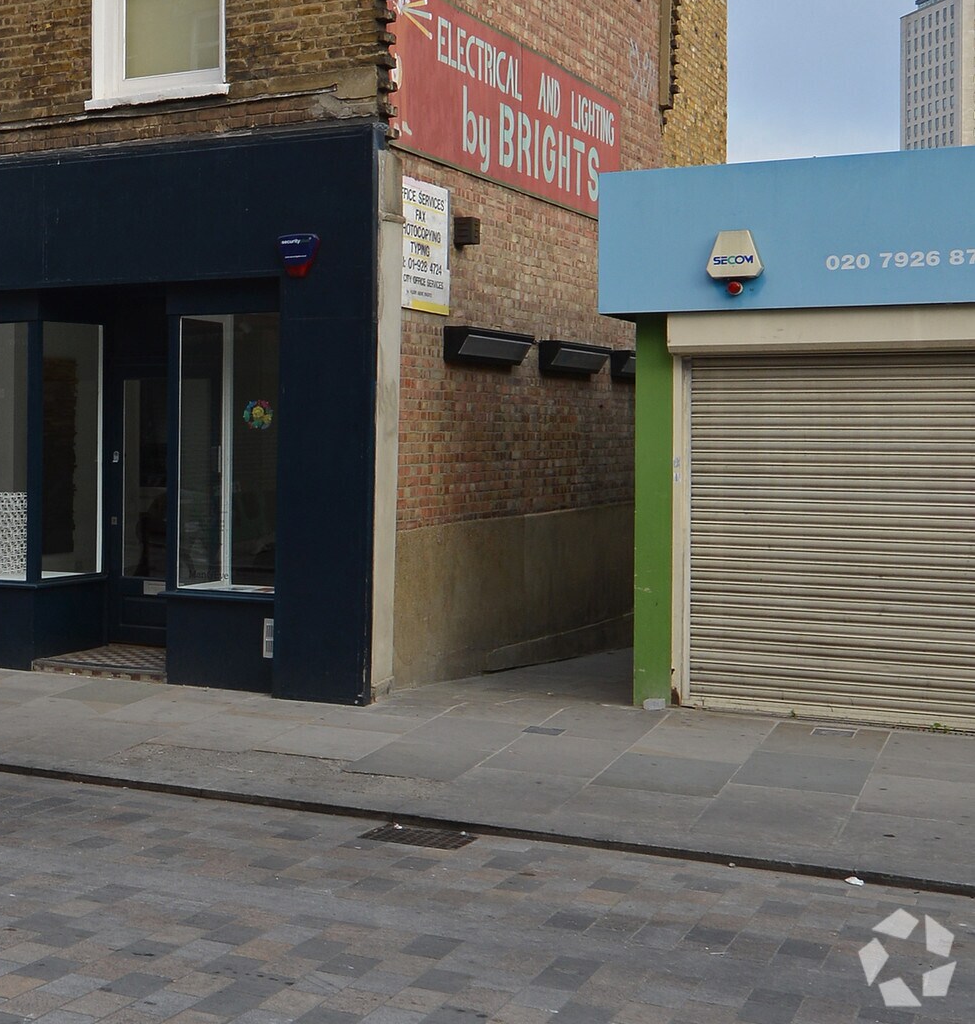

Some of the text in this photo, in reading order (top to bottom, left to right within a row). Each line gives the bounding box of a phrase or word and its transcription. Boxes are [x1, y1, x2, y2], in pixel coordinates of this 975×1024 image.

[437, 15, 615, 147] ELECTRICAL AND LIGHTING
[462, 84, 600, 202] by BRIGHTS
[418, 190, 445, 212] SERVICES
[415, 208, 427, 223] FAX
[403, 223, 442, 244] HOTOCOPYING
[410, 241, 431, 258] TYPING
[713, 254, 754, 266] SECOM
[825, 253, 871, 271] 020
[879, 250, 941, 270] 7926
[412, 275, 426, 287] OFFICE
[426, 279, 444, 290] SERVICES
